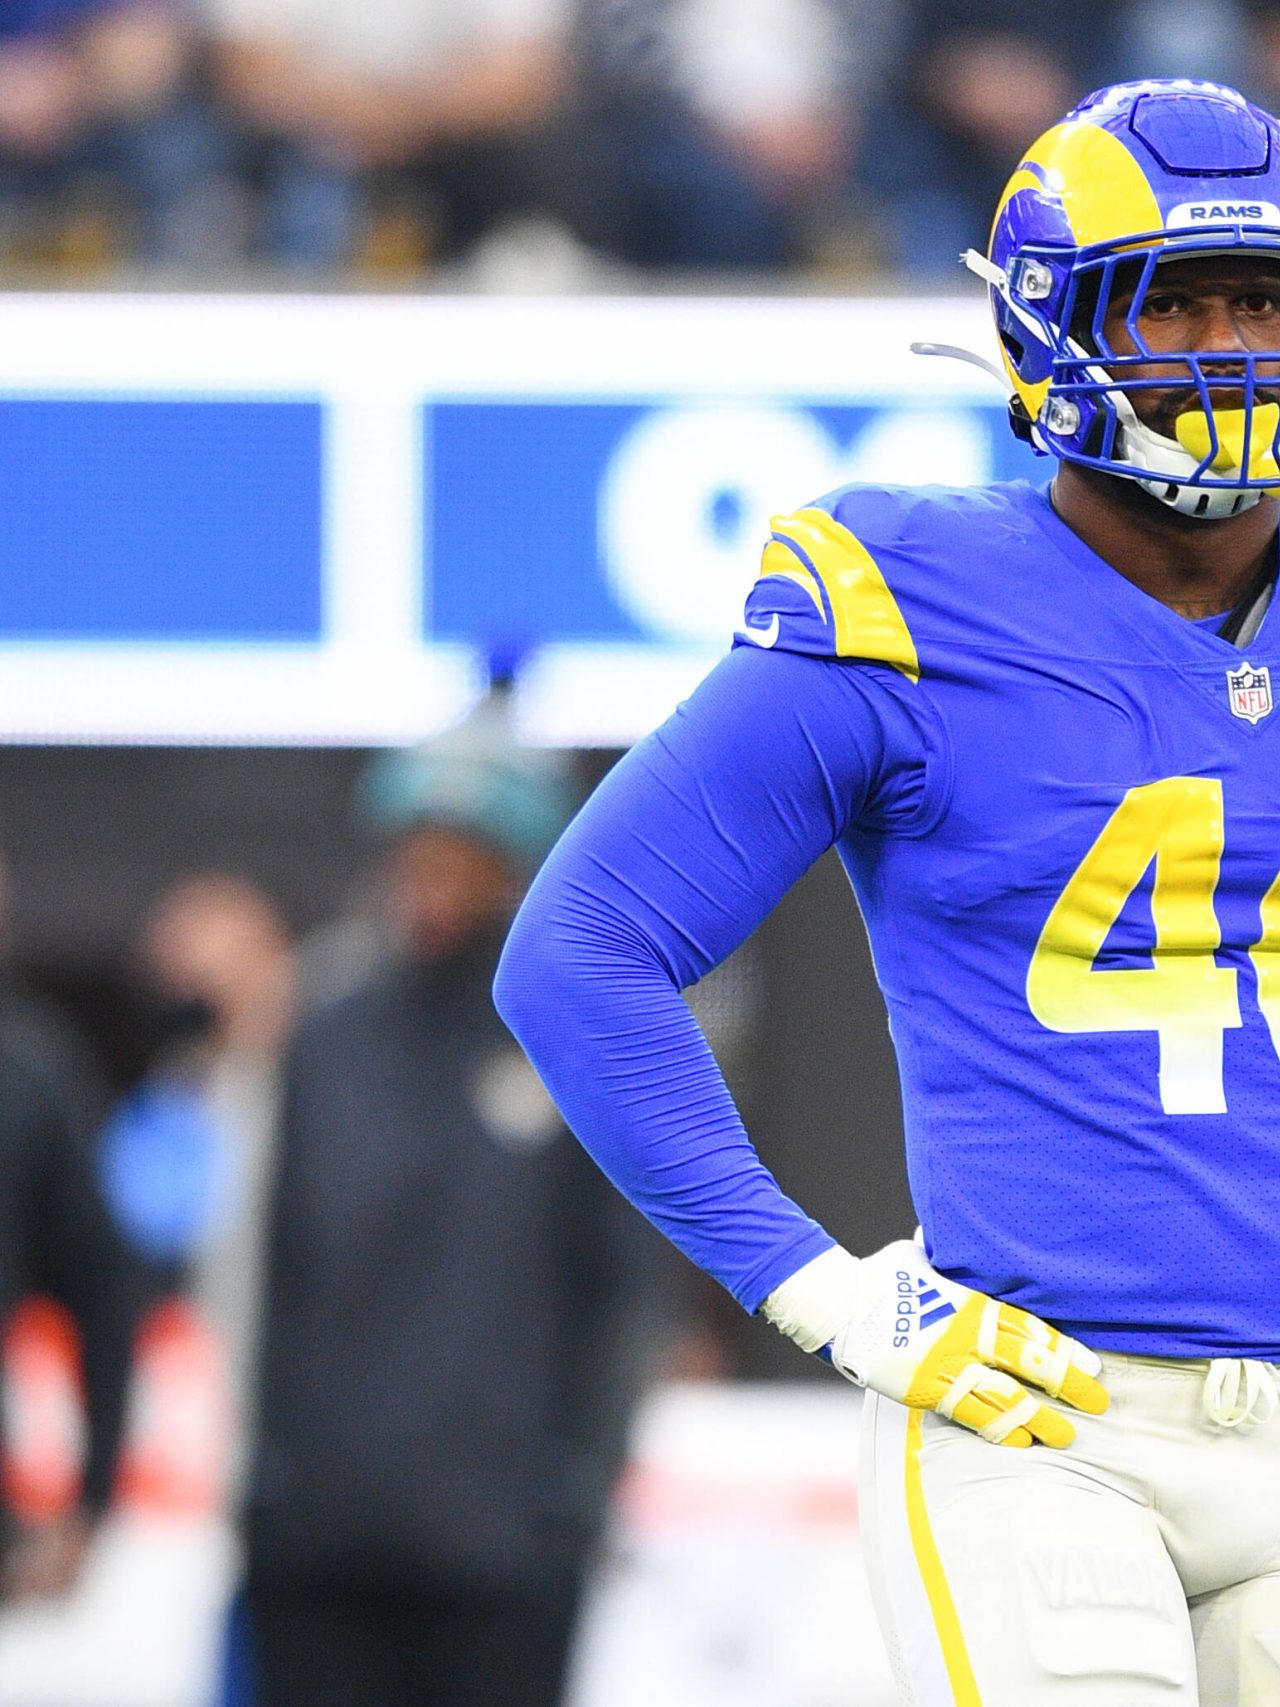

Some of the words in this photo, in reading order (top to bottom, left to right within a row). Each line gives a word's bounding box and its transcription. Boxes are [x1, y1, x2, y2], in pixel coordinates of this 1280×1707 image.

[1189, 205, 1263, 219] RAMS
[1237, 690, 1266, 712] NFL
[893, 1271, 919, 1348] adidas
